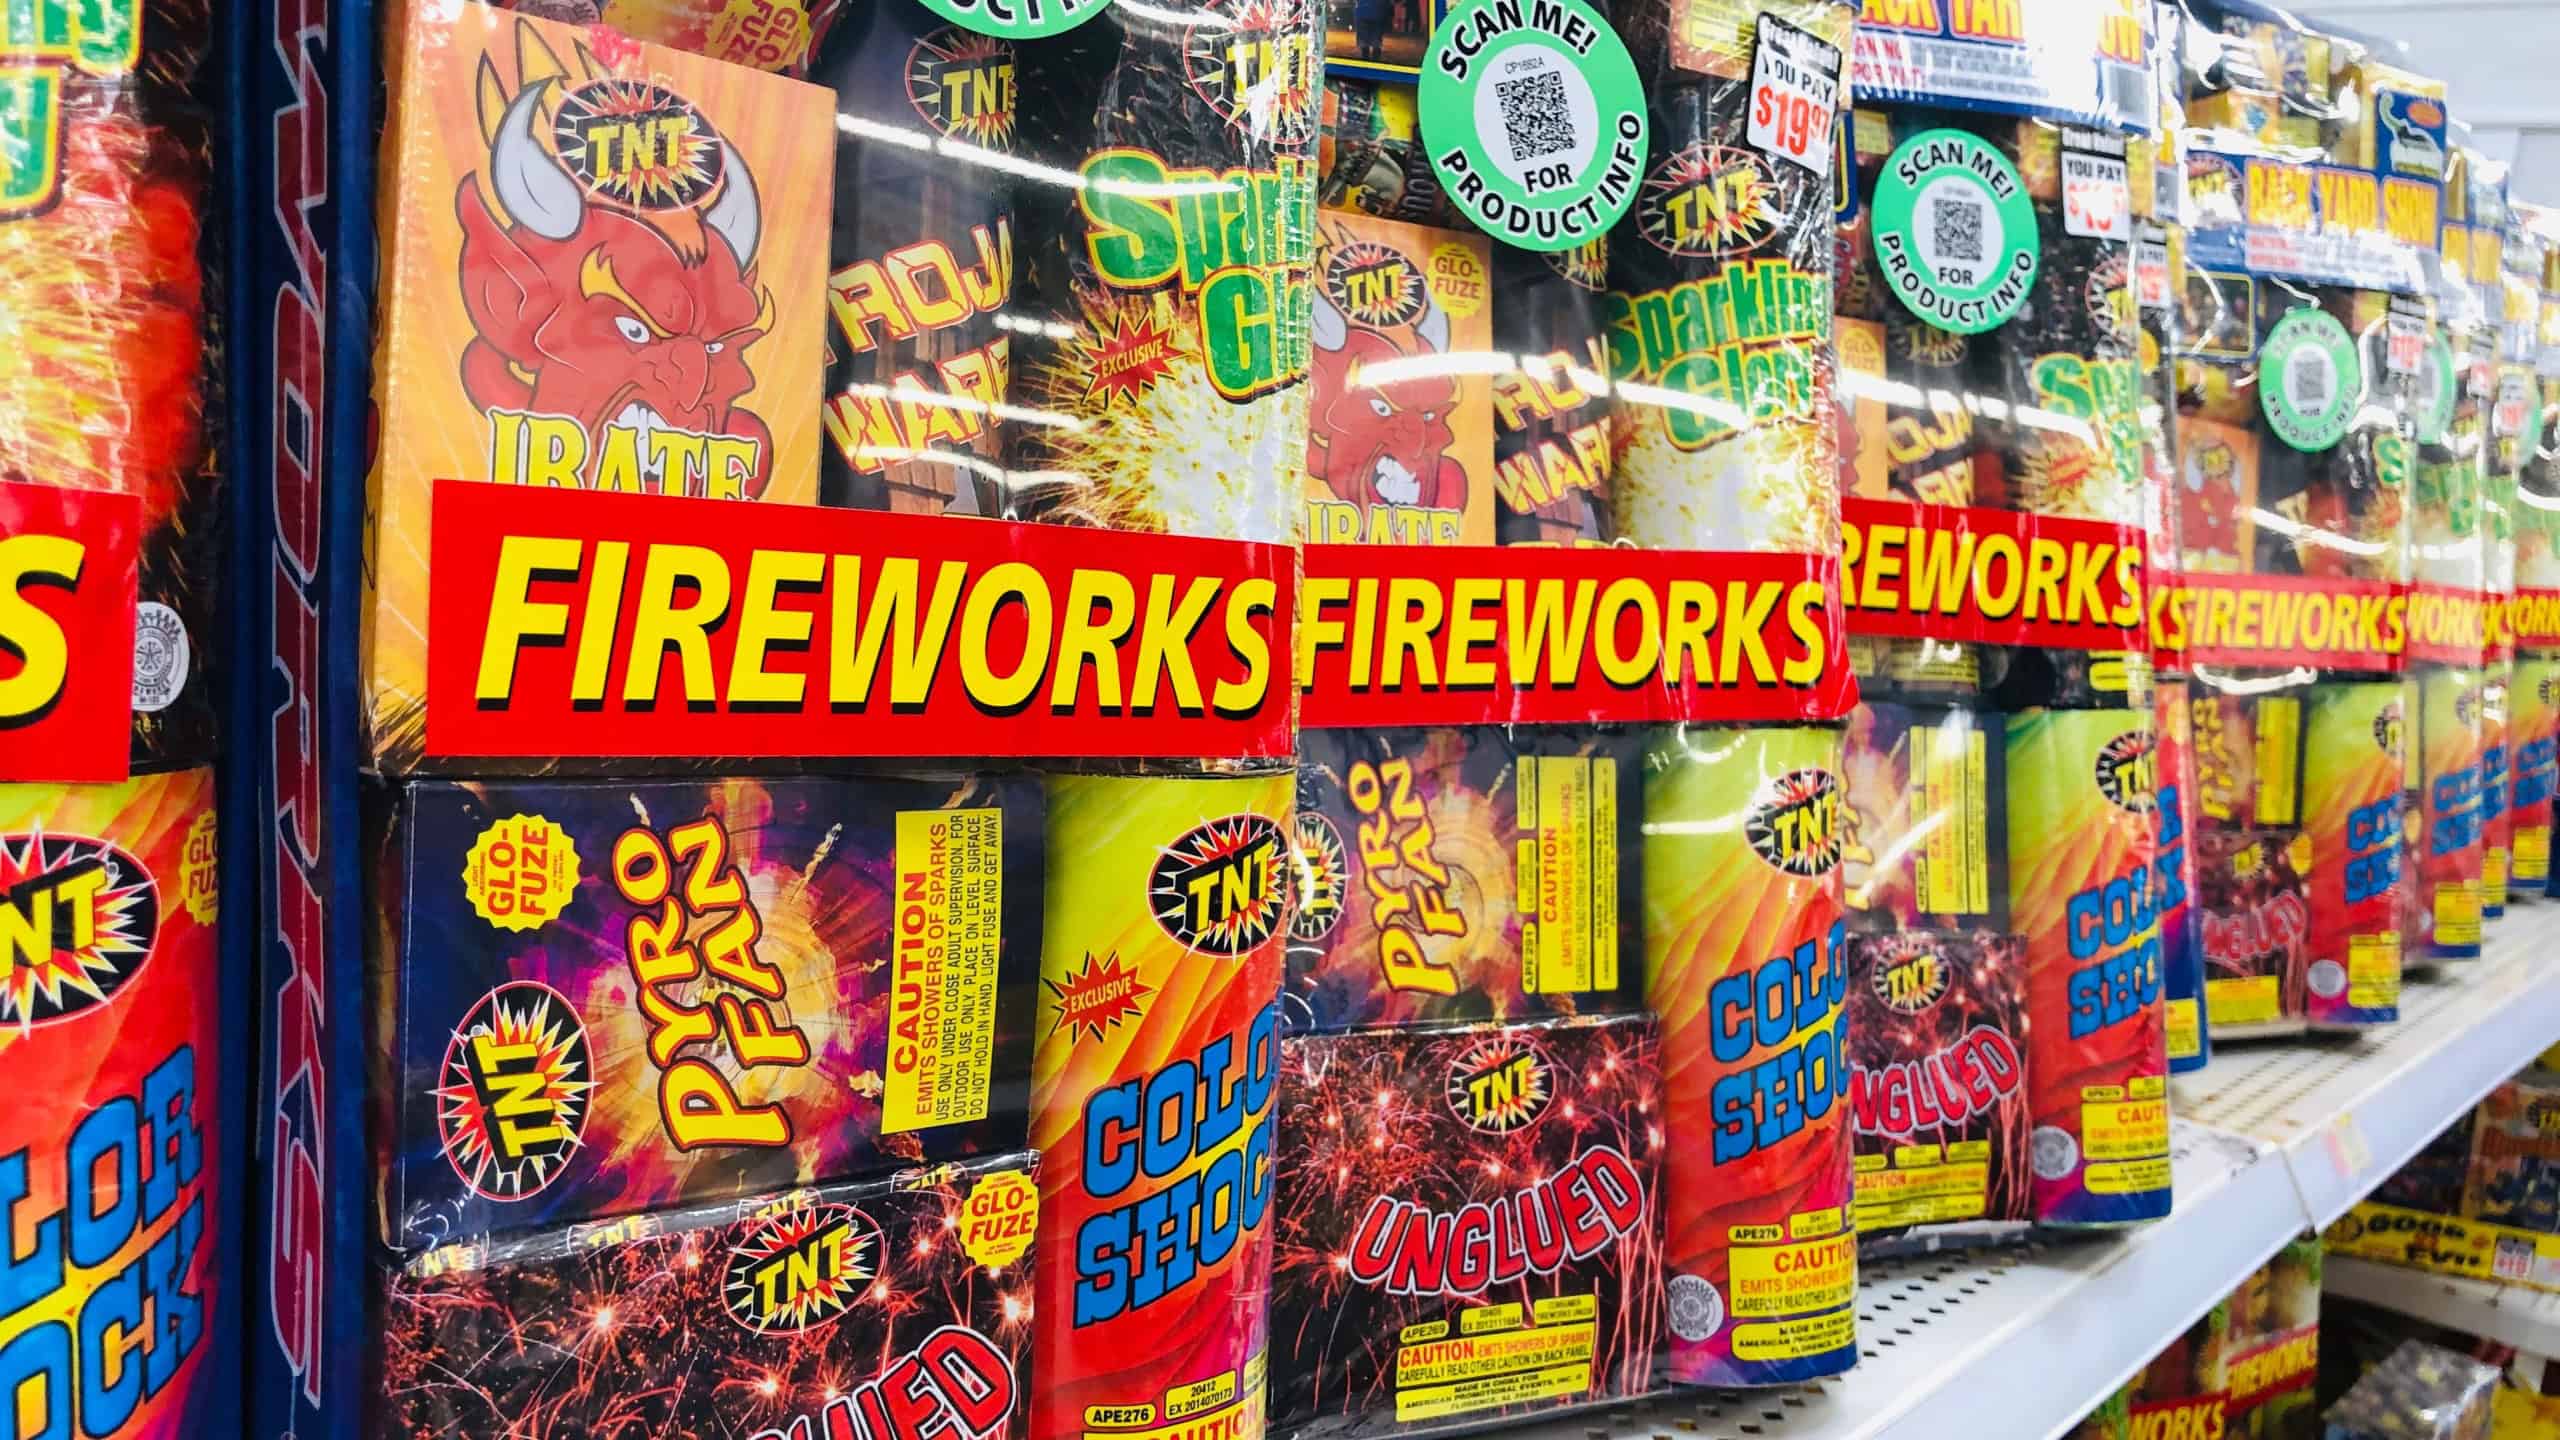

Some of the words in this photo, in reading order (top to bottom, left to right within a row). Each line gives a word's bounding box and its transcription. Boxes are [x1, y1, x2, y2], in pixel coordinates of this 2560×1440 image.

[1442, 0, 1523, 80] SCAN
[1532, 0, 1598, 55] ME!
[1801, 74, 1833, 103] PAY
[588, 116, 690, 178] TNT
[1442, 149, 1600, 239] PRODUCT
[1598, 113, 1641, 206] INFO
[1524, 164, 1573, 193] FOR
[1900, 142, 1963, 185] SCAN
[1972, 149, 2015, 199] ME!
[2065, 159, 2092, 176] YOU
[2096, 162, 2122, 181] PAY
[1666, 167, 1754, 242] TNT
[1346, 263, 1403, 309] TNT
[1435, 277, 1481, 299] FUZE
[1882, 233, 1987, 324] PRODUCT
[1992, 252, 2033, 314] INFO
[1939, 267, 1974, 286] FOR
[1101, 340, 1164, 379] EXCLUSIVE
[475, 534, 1278, 720] FIREWORKS
[1303, 577, 1826, 693] FIREWORKS
[951, 815, 963, 839] FOR
[1775, 793, 1836, 858] TNT
[928, 823, 945, 905] SPARKS
[984, 852, 996, 875] GET
[1380, 757, 1468, 938] FAN
[520, 824, 549, 916] FUZE
[1188, 841, 1274, 932] TNT
[1349, 760, 1461, 996] PYRO
[1544, 828, 1557, 922] CAUTION
[967, 879, 980, 916] LEVEL
[984, 879, 996, 903] AND
[669, 815, 810, 1068] FAN
[928, 916, 944, 940] OF
[966, 923, 978, 939] ON
[983, 909, 995, 937] FUSE
[948, 932, 961, 968] ADULT
[964, 947, 977, 985] PLACE
[981, 943, 994, 976] LIGHT
[611, 827, 792, 1151] PYRO
[893, 872, 926, 1073] CAUTION
[1887, 954, 1935, 1000] TNT
[922, 946, 943, 1049] SHOWERS
[945, 974, 959, 1012] CLOSE
[1071, 976, 1132, 1013] EXCLUSIVE
[942, 1018, 957, 1057] UNDER
[959, 1031, 972, 1054] USE
[976, 1020, 989, 1031] IN
[974, 1036, 988, 1066] HOLD
[916, 1056, 936, 1115] EMITS
[938, 1063, 952, 1092] ONLY
[953, 1060, 969, 1117] OUTDOOR
[972, 1071, 986, 1094] NOT
[1469, 1055, 1532, 1118] TNT
[474, 1035, 566, 1159] TNT
[935, 1098, 950, 1120] USE
[970, 1099, 984, 1115] DO
[968, 1211, 1034, 1245] FUZE
[1351, 1146, 1644, 1295] UNGLUED
[755, 1223, 850, 1318] TNT
[1399, 1340, 1474, 1369] CAUTION
[1469, 1358, 1496, 1374] OTHER
[1497, 1354, 1530, 1370] CAUTION
[1093, 1409, 1149, 1423] APE276
[1168, 1403, 1182, 1415] EX
